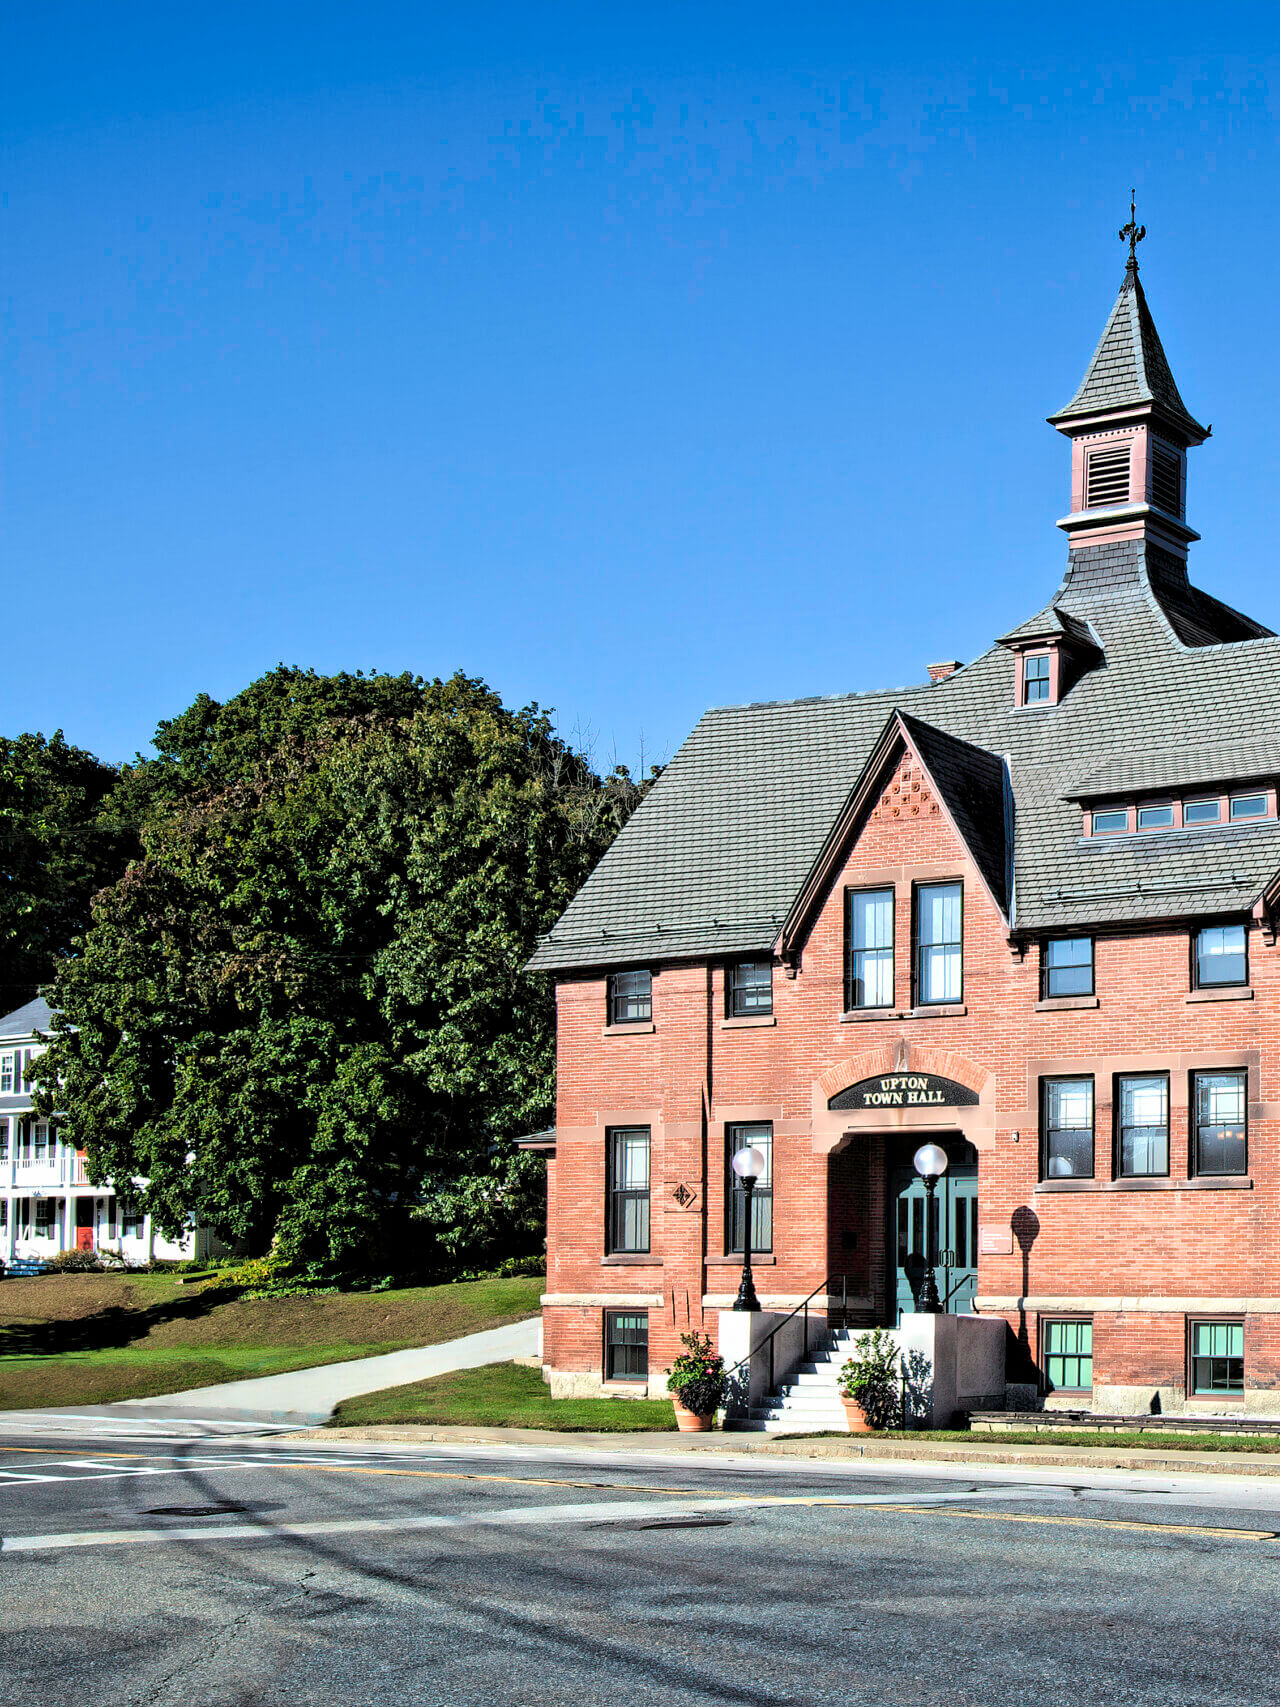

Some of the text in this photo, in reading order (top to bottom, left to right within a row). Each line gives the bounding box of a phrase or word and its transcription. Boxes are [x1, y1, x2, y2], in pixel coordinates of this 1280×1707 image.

[881, 1077, 929, 1091] UPTON
[863, 1090, 945, 1105] TOWN HALL
